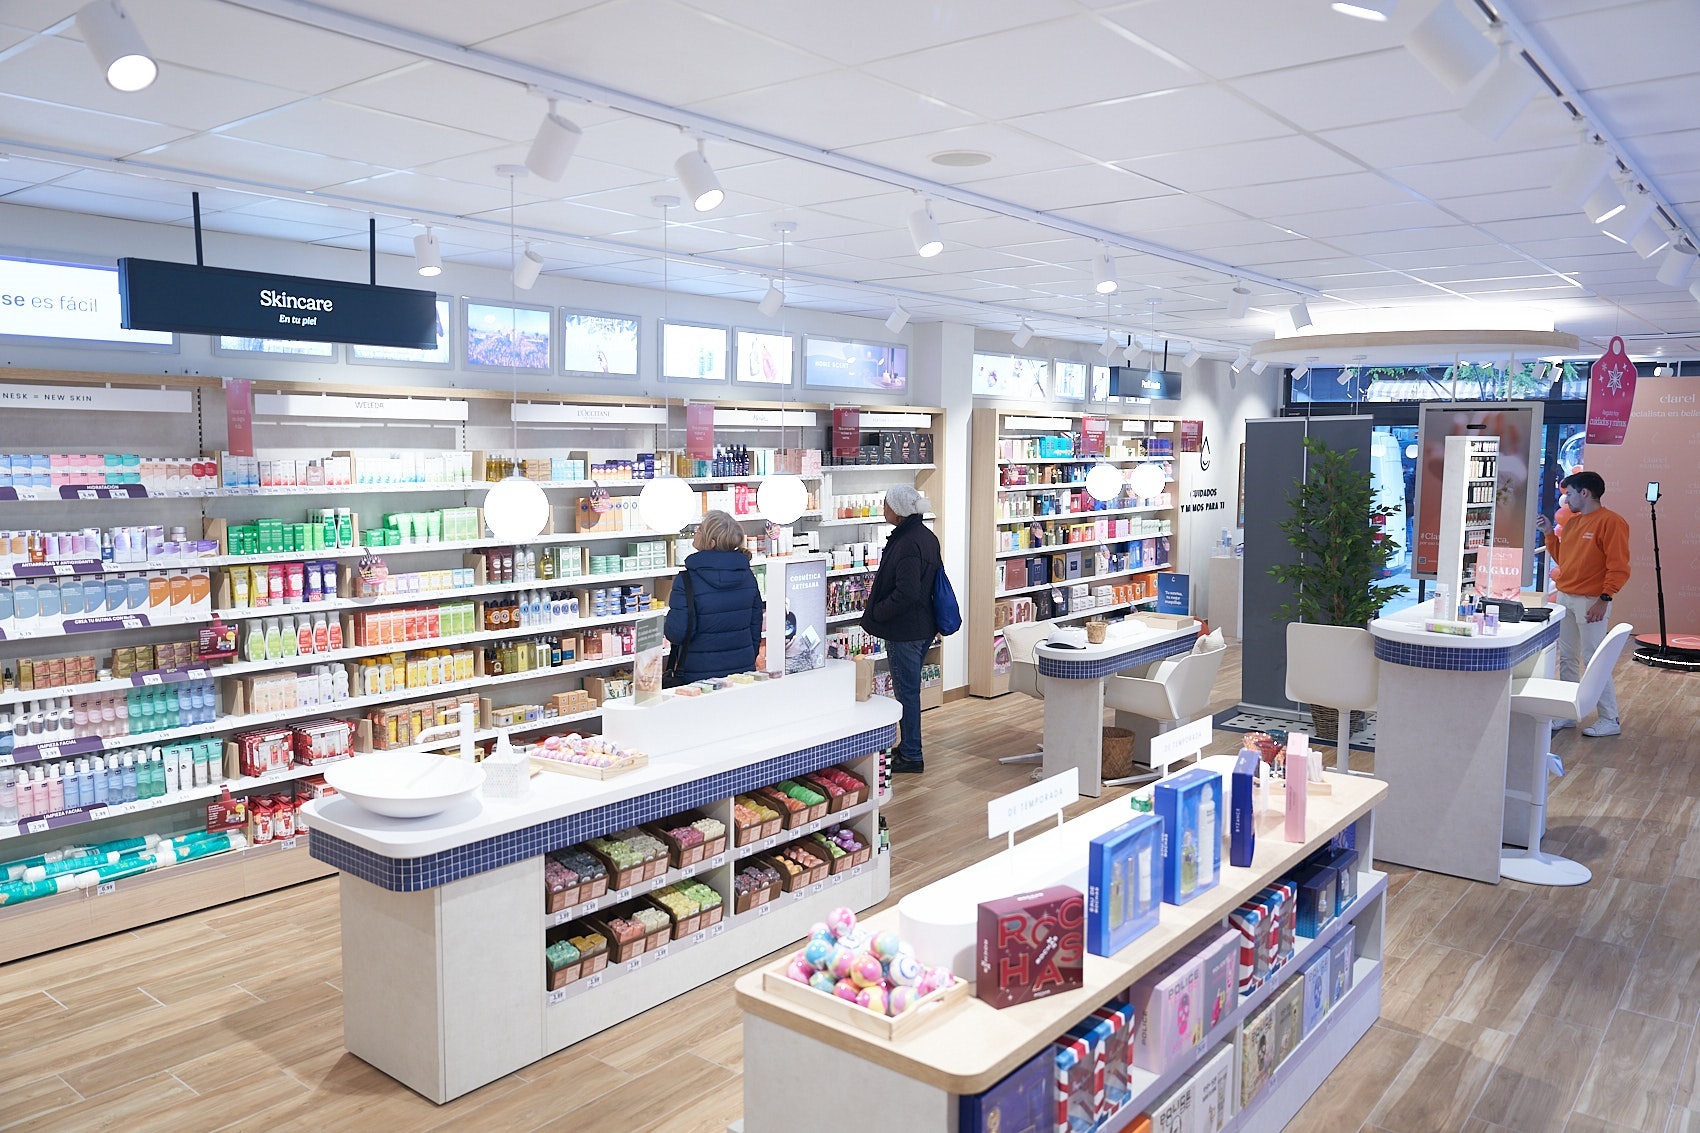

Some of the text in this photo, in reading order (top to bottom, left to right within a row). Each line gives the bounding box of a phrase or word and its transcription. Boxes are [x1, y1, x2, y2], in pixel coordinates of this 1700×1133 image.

[31, 296, 54, 310] es
[60, 296, 98, 312] fácil
[260, 290, 333, 312] Skincare
[279, 314, 317, 326] En tu piel
[1660, 394, 1696, 403] clarel
[790, 573, 821, 582] COSMÉTICA
[1007, 788, 1063, 816] DE TEMPORADA
[1168, 969, 1199, 997] POLICE
[1160, 1089, 1191, 1126] POLICE
